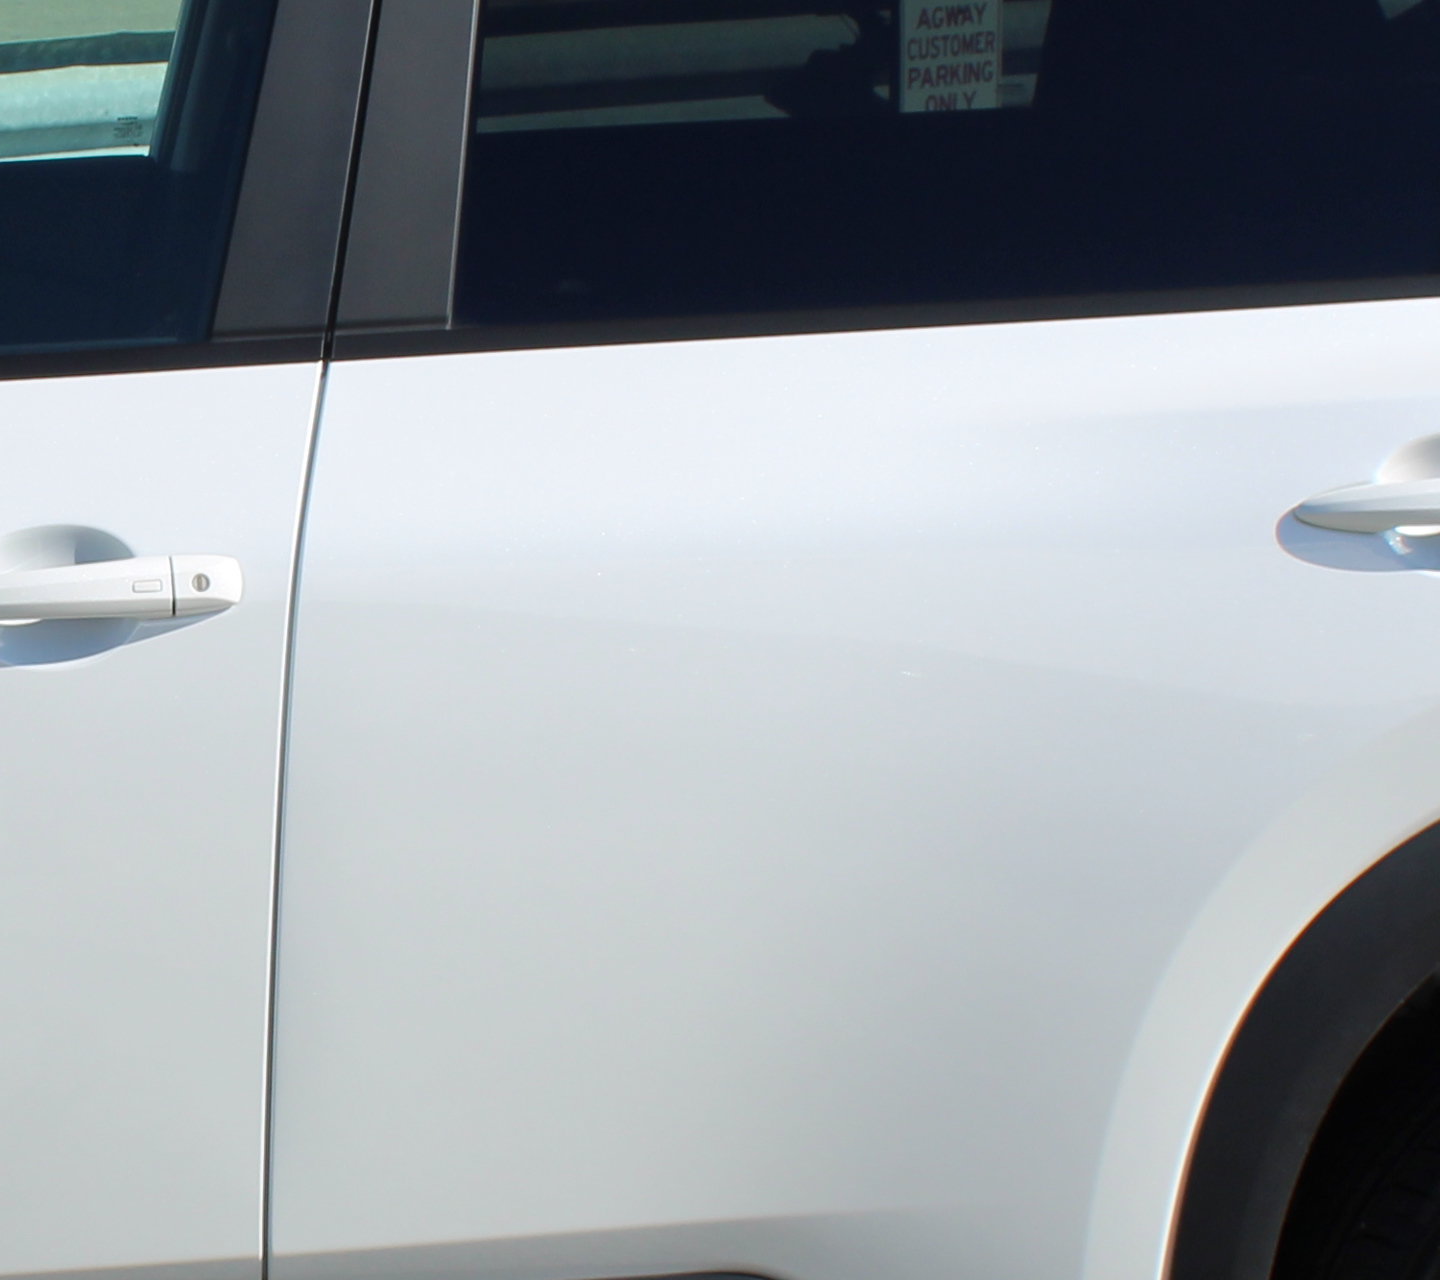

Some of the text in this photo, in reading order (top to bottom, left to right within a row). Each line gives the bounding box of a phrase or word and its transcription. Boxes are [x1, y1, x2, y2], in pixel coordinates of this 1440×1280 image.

[916, 2, 988, 30] AGWAY
[907, 31, 996, 60] CUSTOMER
[907, 61, 994, 91] PARKING
